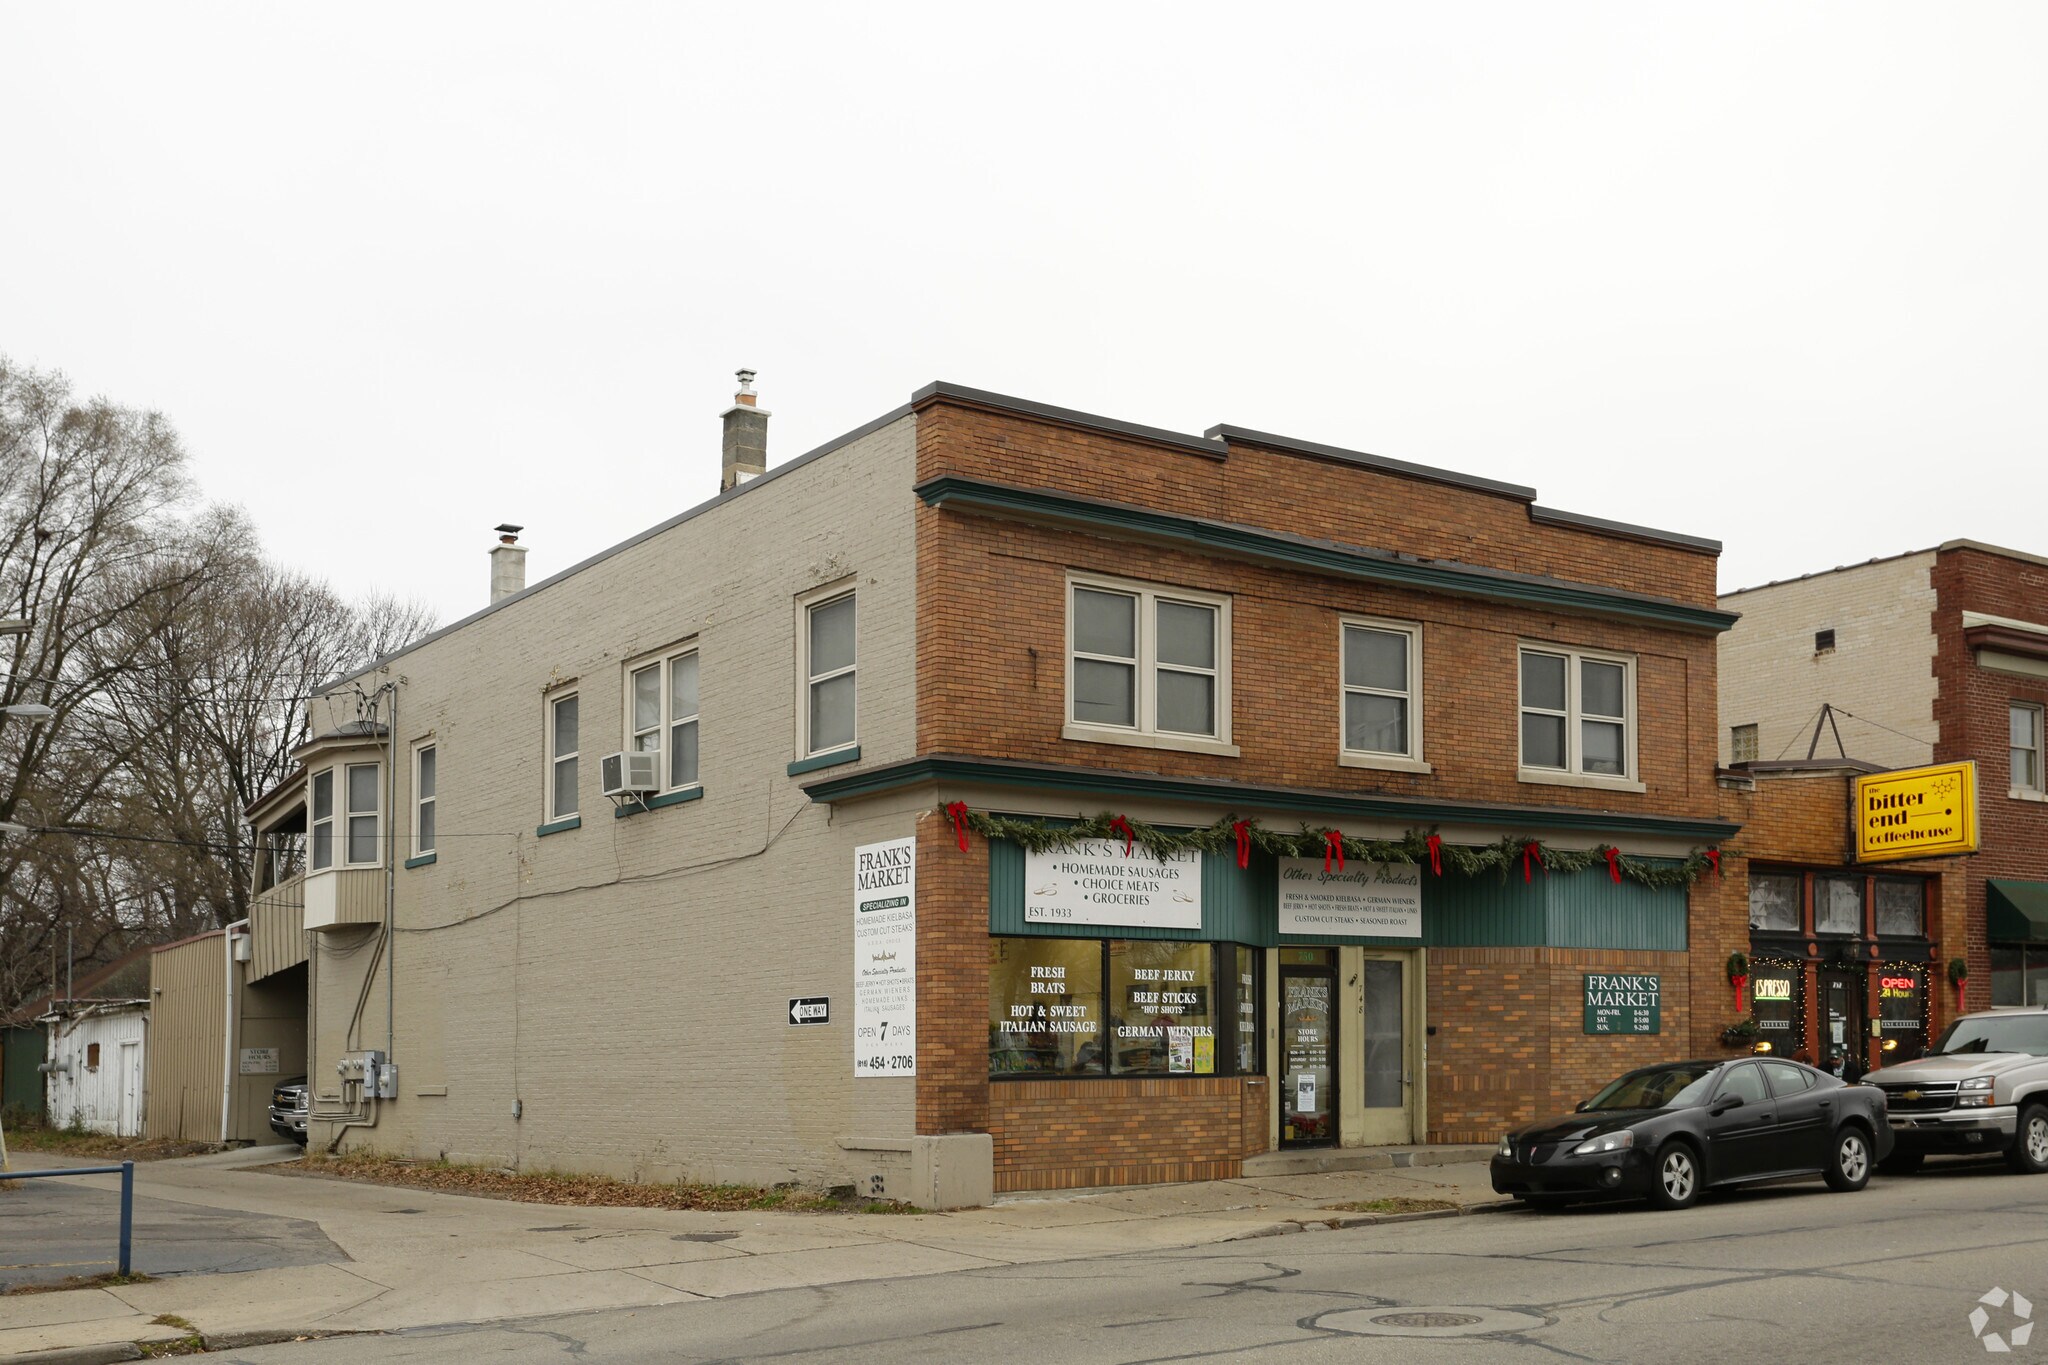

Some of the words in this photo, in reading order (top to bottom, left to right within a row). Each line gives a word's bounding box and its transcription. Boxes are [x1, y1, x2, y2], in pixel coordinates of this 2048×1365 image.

[1869, 793, 1923, 810] bitter
[1869, 810, 1907, 829] end
[1869, 827, 1952, 844] coffeehouse
[1029, 841, 1113, 858] RANK'S
[859, 846, 911, 871] FRANK'S
[1061, 862, 1126, 877] HOMEMADE
[1127, 866, 1180, 880] SAUSAGES
[1283, 867, 1312, 880] Other
[1318, 870, 1369, 887] Specialty
[1374, 873, 1418, 886] Products
[858, 866, 912, 891] MARKET
[1082, 877, 1124, 891] CHOICE
[1126, 880, 1160, 893] MEATS
[862, 899, 899, 911] SPECIALIZING
[900, 897, 907, 906] IN
[1092, 893, 1150, 906] GROCERIES
[1286, 893, 1303, 901] FRESH
[1310, 894, 1335, 902] SMOKED
[1336, 895, 1361, 903] KIELBASA
[1367, 896, 1391, 904] GERMAN
[1392, 897, 1416, 905] WIENERS
[857, 914, 886, 926] HOMEMADE
[887, 911, 913, 922] KIELBASA
[1029, 906, 1048, 918] EST.
[1050, 907, 1072, 918] 1933
[1295, 915, 1320, 923] CUSTOM
[1360, 917, 1389, 925] SEASONED
[1031, 967, 1065, 978] FRESH
[1134, 969, 1161, 980] BEEF
[1162, 970, 1195, 981] JERKY
[1031, 982, 1065, 994] BRATS
[1588, 976, 1658, 991] FRANK'S
[1755, 979, 1790, 997] ESPRESSO
[1881, 977, 1914, 988] OPEN
[1133, 992, 1159, 1003] BEEF
[1162, 992, 1197, 1003] STICKS
[1288, 986, 1328, 998] FRANK'S
[1288, 997, 1329, 1015] MARKET
[1587, 992, 1658, 1007] MARKET
[800, 1006, 812, 1016] ONE
[813, 1005, 825, 1015] WAY
[1011, 1005, 1034, 1017] HOT
[1038, 1006, 1046, 1017] &
[1050, 1006, 1087, 1017] SWEET
[858, 1027, 876, 1037] OPEN
[880, 1022, 888, 1041] 7
[893, 1025, 911, 1036] DAYS
[1000, 1021, 1046, 1032] ITALIAN
[1050, 1021, 1097, 1033] SAUSAGE
[1118, 1026, 1163, 1037] GERMAN
[1167, 1026, 1213, 1037] WIENERS
[870, 1056, 885, 1069] 454
[891, 1055, 913, 1069] 2706
